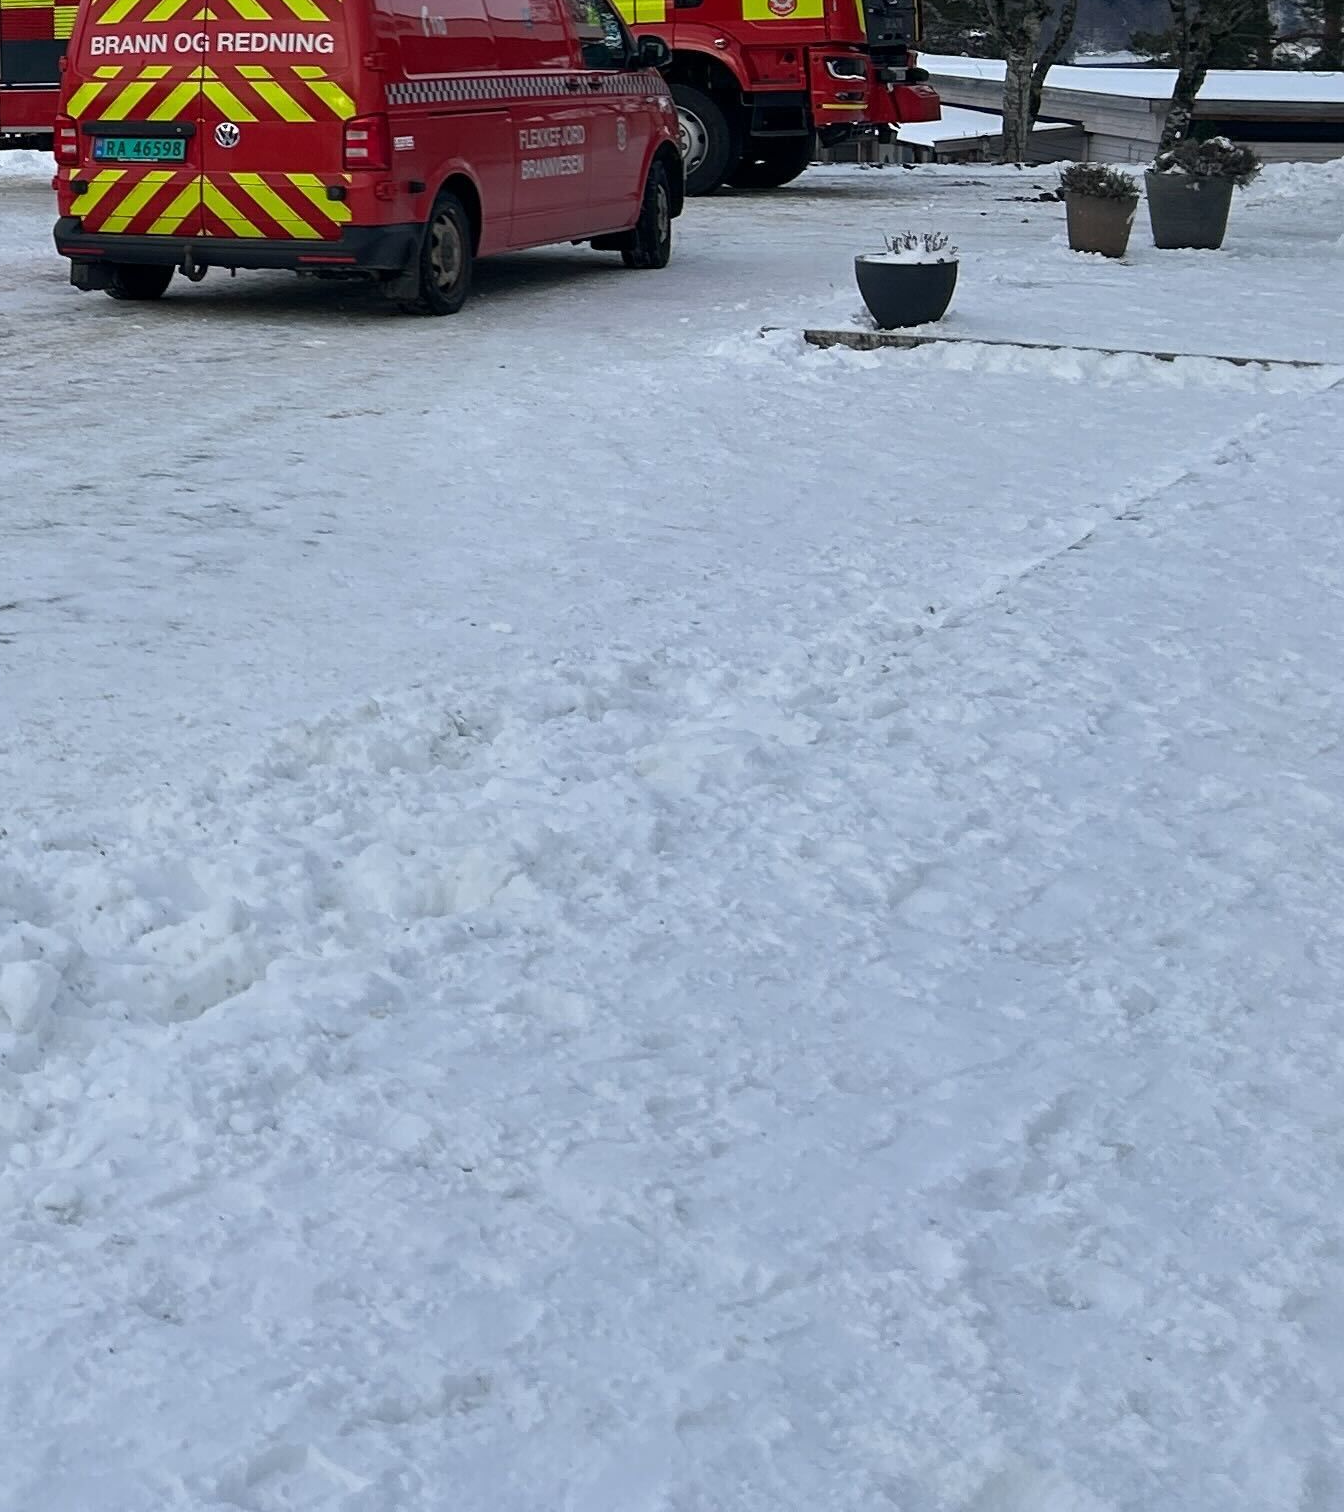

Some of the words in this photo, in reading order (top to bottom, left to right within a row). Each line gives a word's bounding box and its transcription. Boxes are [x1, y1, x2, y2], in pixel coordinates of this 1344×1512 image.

[90, 34, 167, 55] BRANN
[174, 33, 210, 53] OG
[217, 33, 334, 54] REDNING
[106, 141, 126, 156] RA
[133, 141, 182, 156] 46598
[519, 125, 585, 150] FLEKKEFJORD
